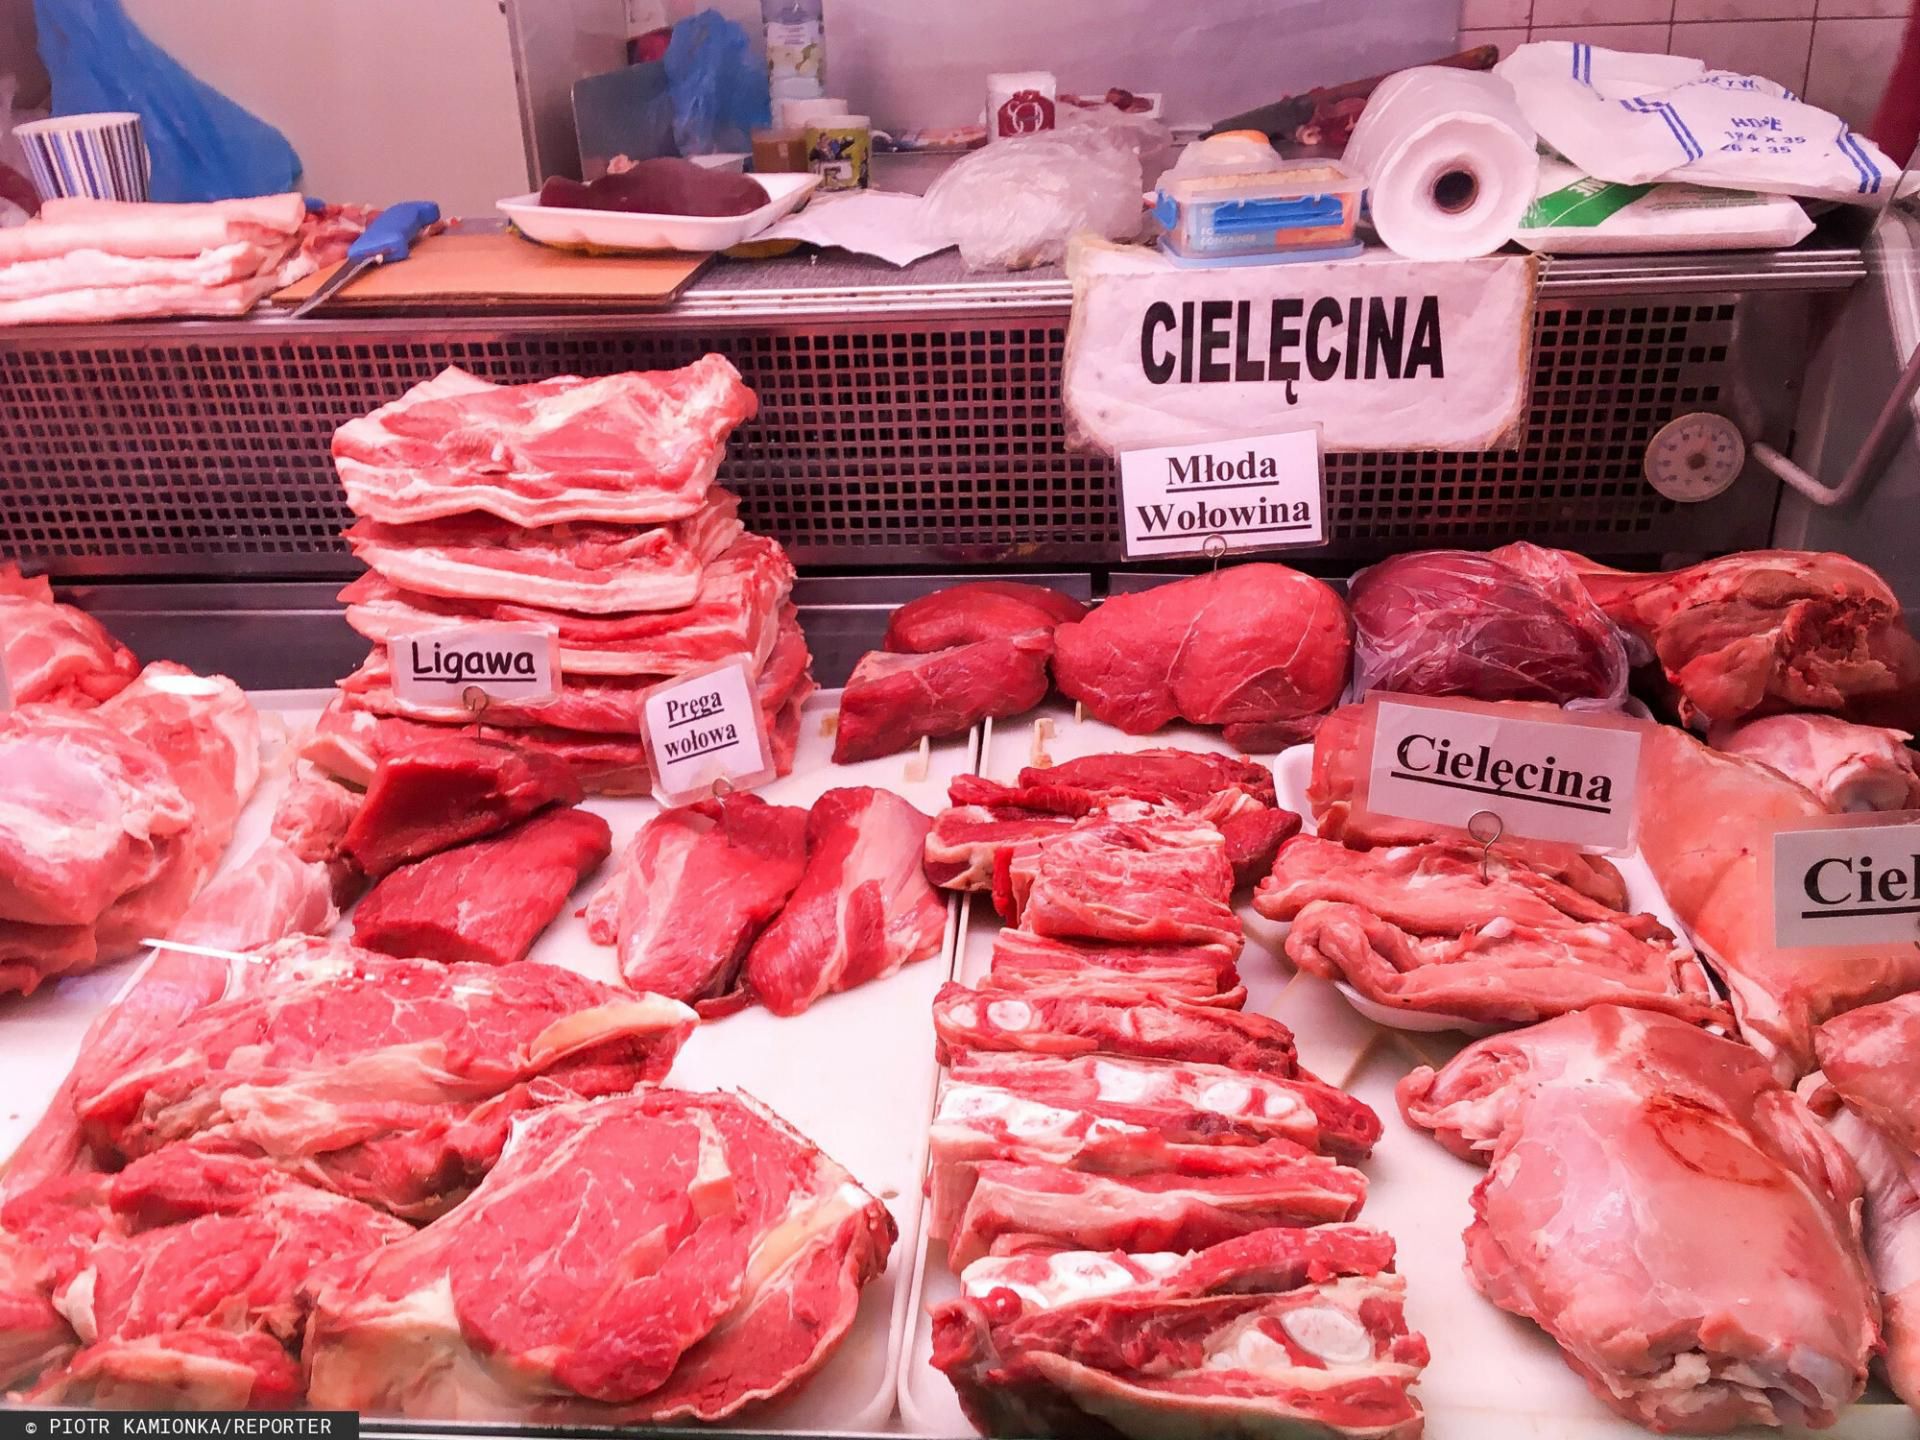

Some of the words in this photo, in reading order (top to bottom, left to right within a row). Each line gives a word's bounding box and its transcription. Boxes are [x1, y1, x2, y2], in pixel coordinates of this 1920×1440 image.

[1140, 295, 1445, 405] CIELĘCINA
[1167, 451, 1279, 486] Młoda
[1137, 497, 1312, 533] Wołowina
[411, 641, 537, 684] Ligawa
[666, 691, 723, 723] Pręga
[664, 723, 738, 758] wołowa
[1396, 733, 1613, 803] Cielęcina
